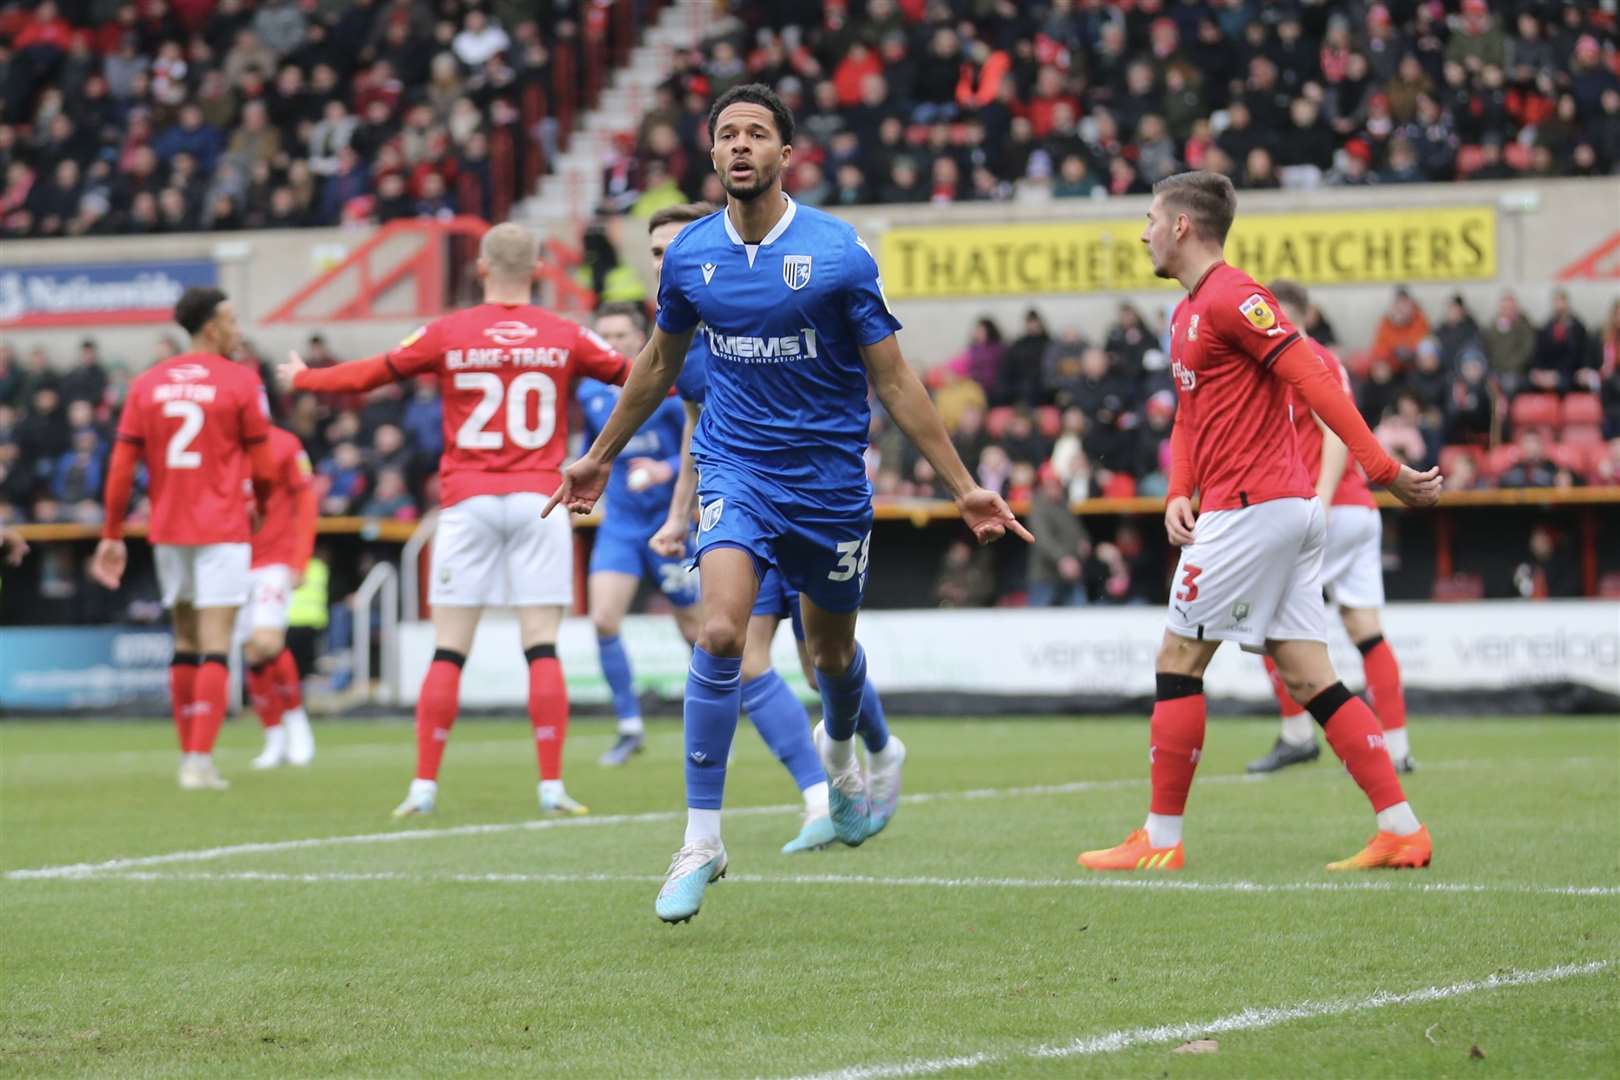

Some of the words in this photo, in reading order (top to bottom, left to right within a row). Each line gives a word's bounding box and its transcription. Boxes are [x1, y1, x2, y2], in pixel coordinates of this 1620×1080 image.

[895, 238, 1156, 289] THATCHER
[1235, 219, 1486, 275] HATCHERS
[446, 346, 570, 370] BLAKE-TRACY
[715, 335, 801, 357] MEMS
[163, 400, 205, 470] 2
[453, 371, 558, 451] 20
[827, 530, 872, 582] 38
[1175, 563, 1203, 603] 3
